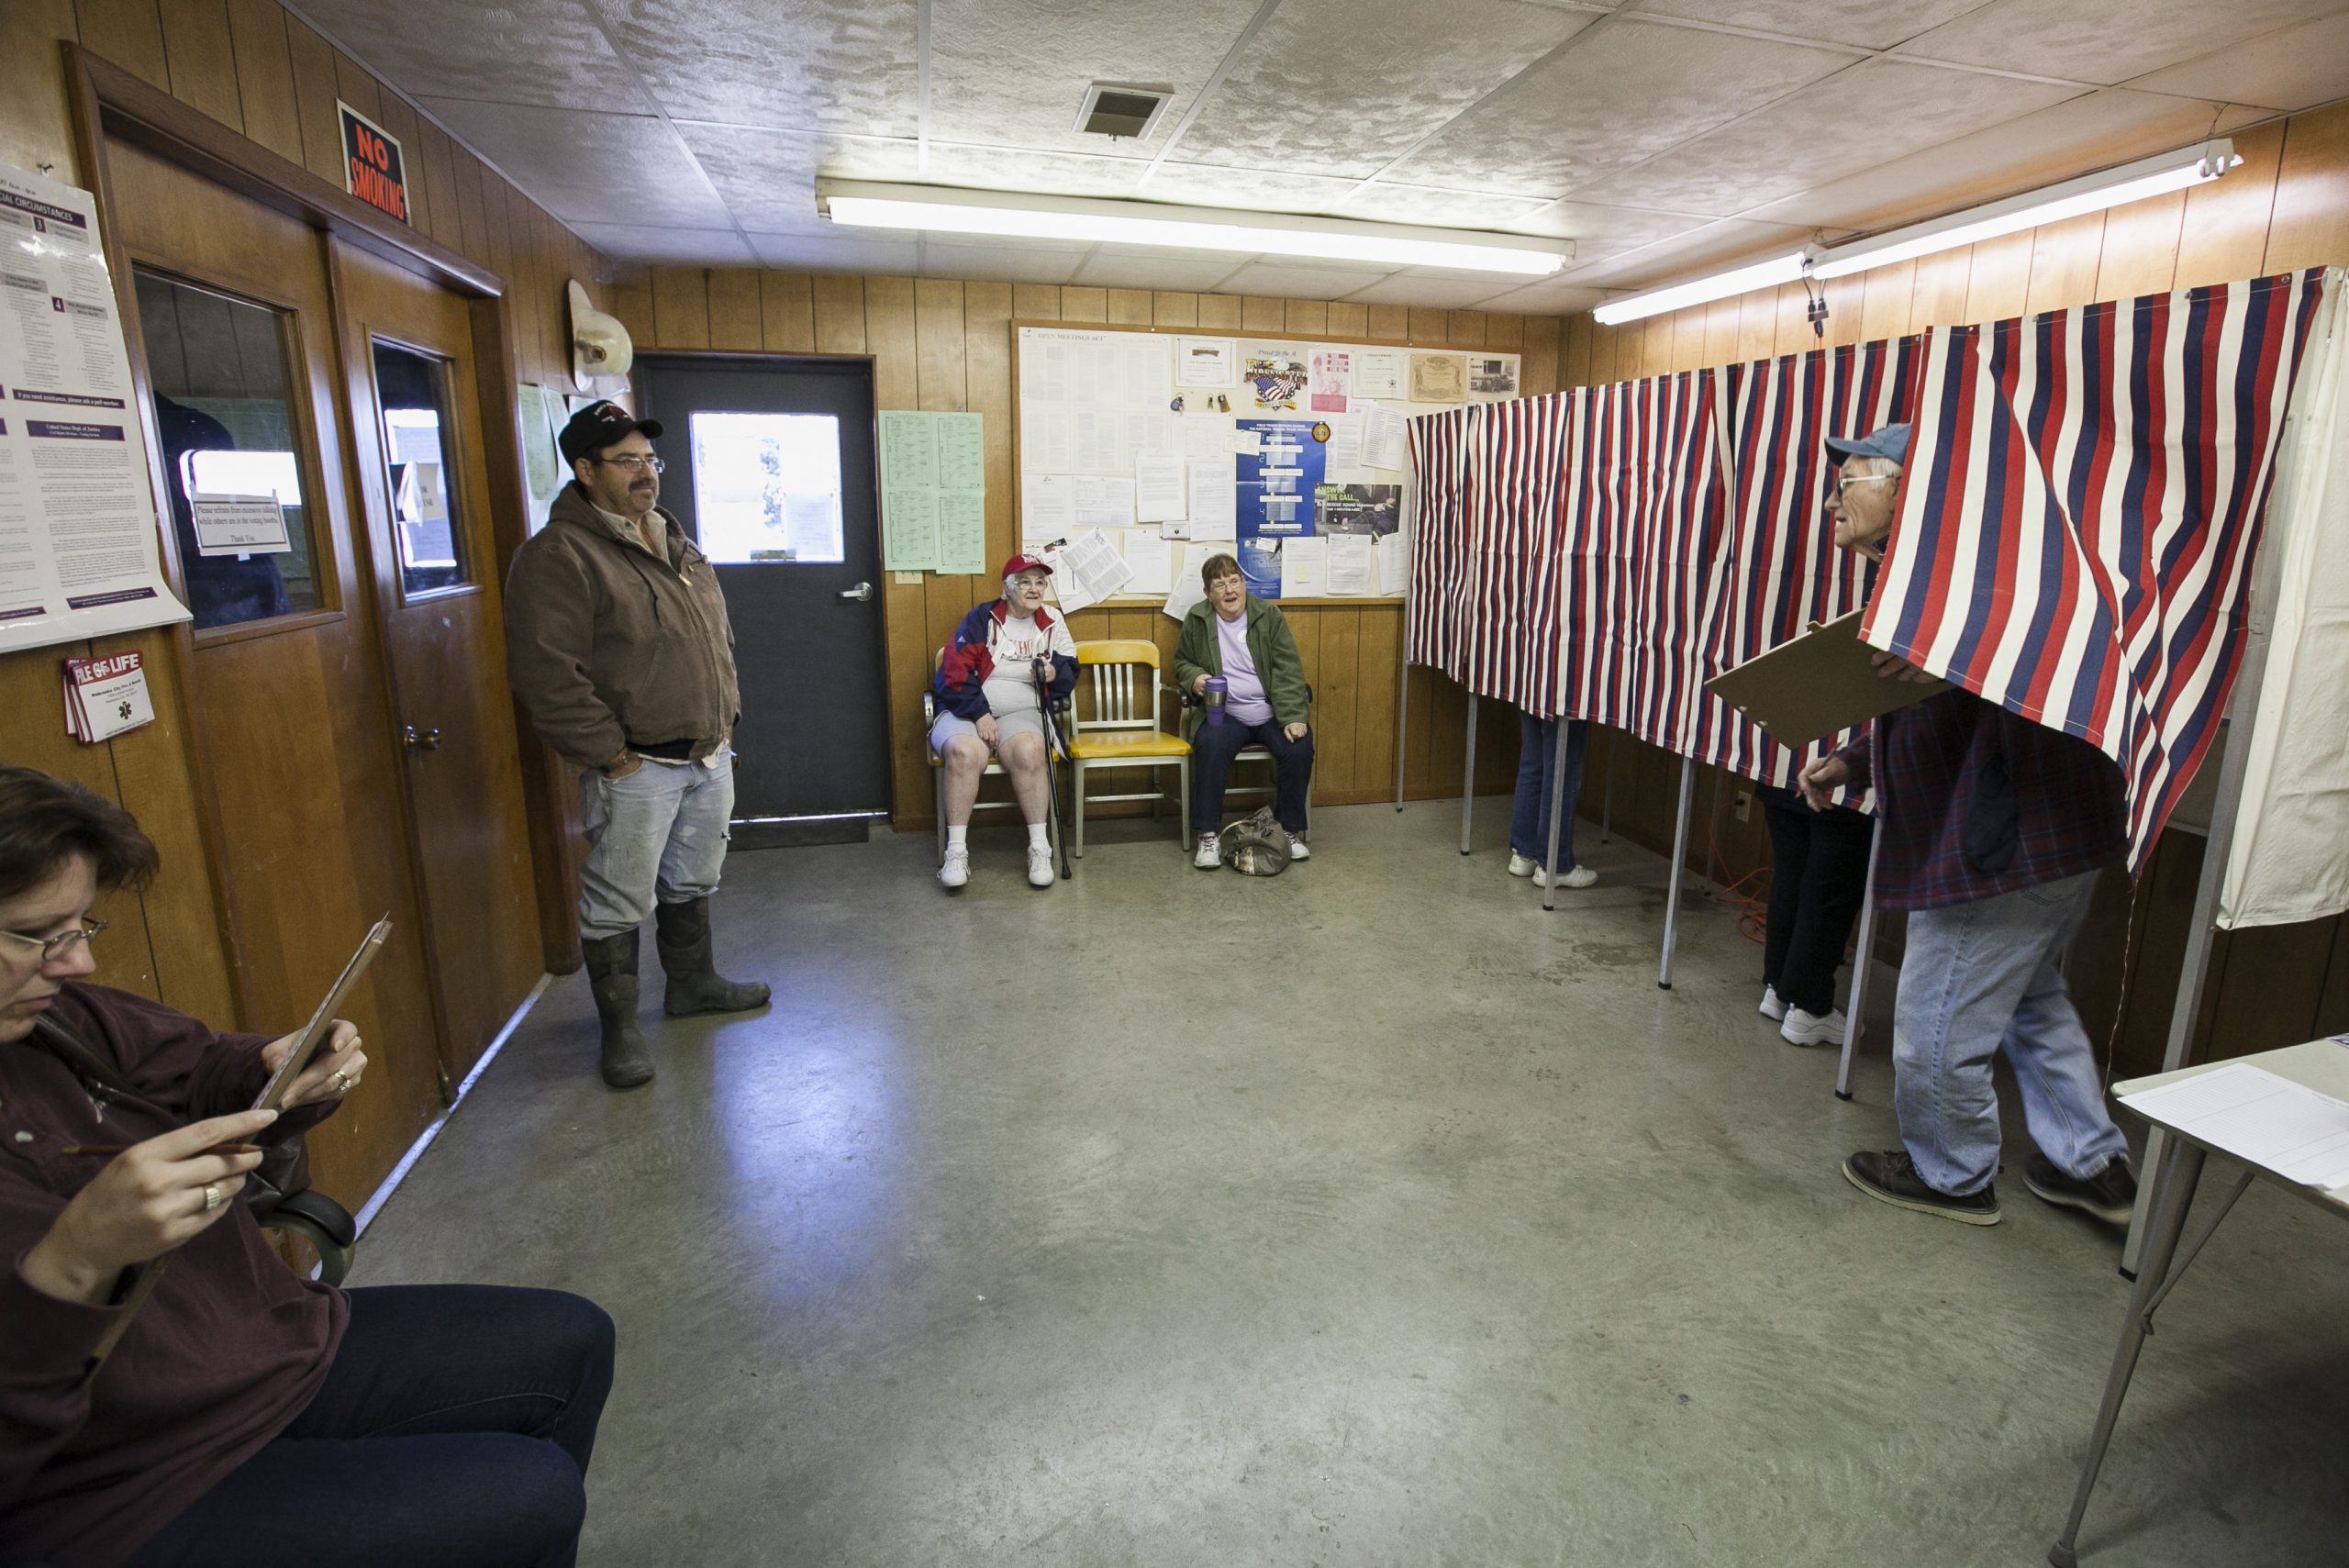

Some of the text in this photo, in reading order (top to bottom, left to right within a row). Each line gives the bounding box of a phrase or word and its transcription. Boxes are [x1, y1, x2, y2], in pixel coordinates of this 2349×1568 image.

[355, 123, 389, 172] NO
[351, 156, 405, 221] SMOKING
[15, 196, 73, 222] CIRCUMSTANCES
[36, 219, 43, 230] 3
[55, 299, 61, 309] 4
[1259, 454, 1265, 462] 2
[1259, 480, 1265, 488] 3
[197, 506, 213, 514] Please
[213, 506, 229, 514] refrain
[229, 506, 241, 514] from
[262, 506, 277, 515] talking
[249, 517, 263, 526] voting
[229, 534, 245, 542] Thank
[75, 653, 139, 684] FILE OF LIFE
